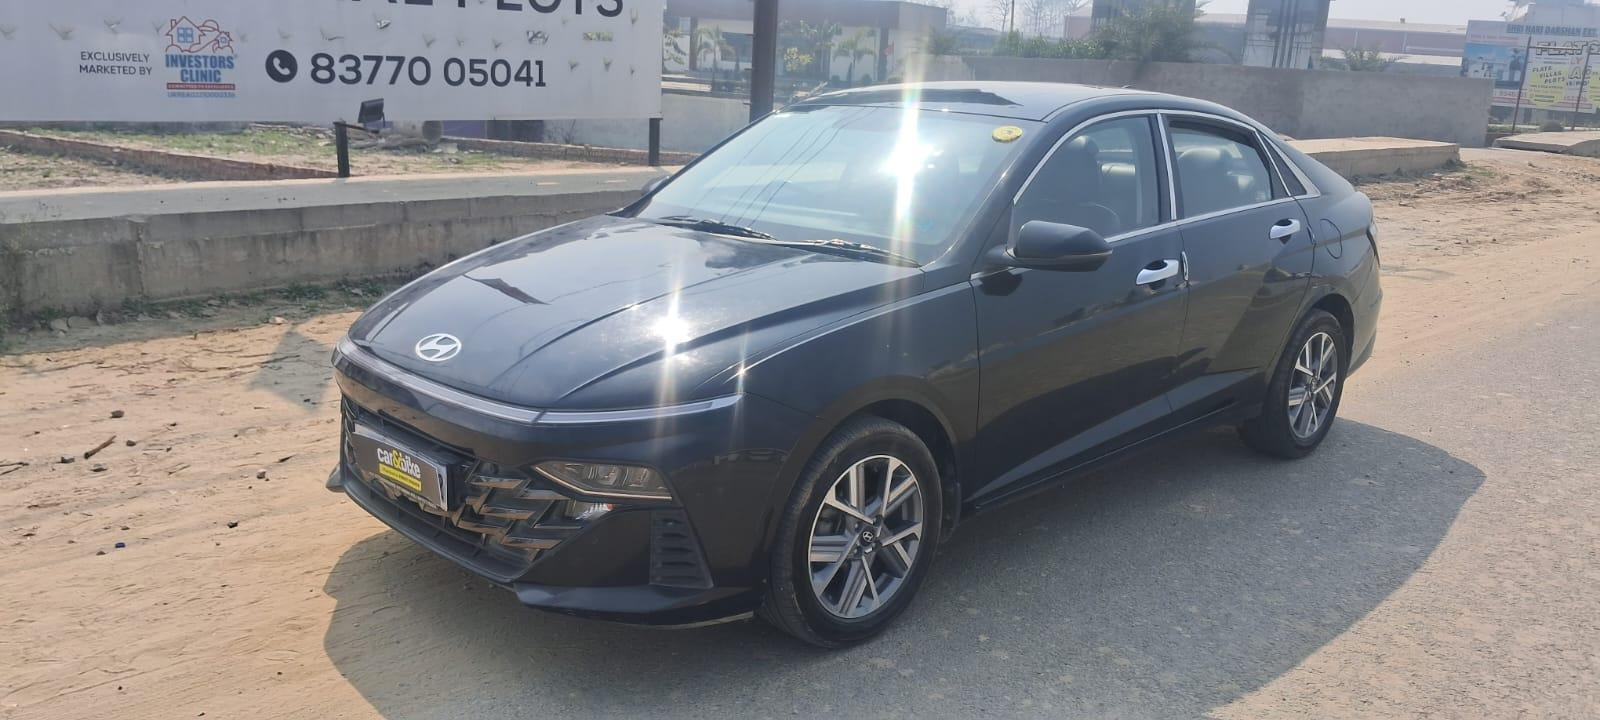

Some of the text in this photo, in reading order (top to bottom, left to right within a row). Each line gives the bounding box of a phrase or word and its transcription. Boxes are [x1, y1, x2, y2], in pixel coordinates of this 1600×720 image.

[80, 51, 150, 63] EXCLUSIVELY
[165, 54, 235, 69] INVESTORS
[79, 65, 152, 75] MARKETED BY
[180, 69, 221, 82] CLINIC
[310, 53, 546, 87] 83770 05041
[377, 448, 421, 478] car&bike
